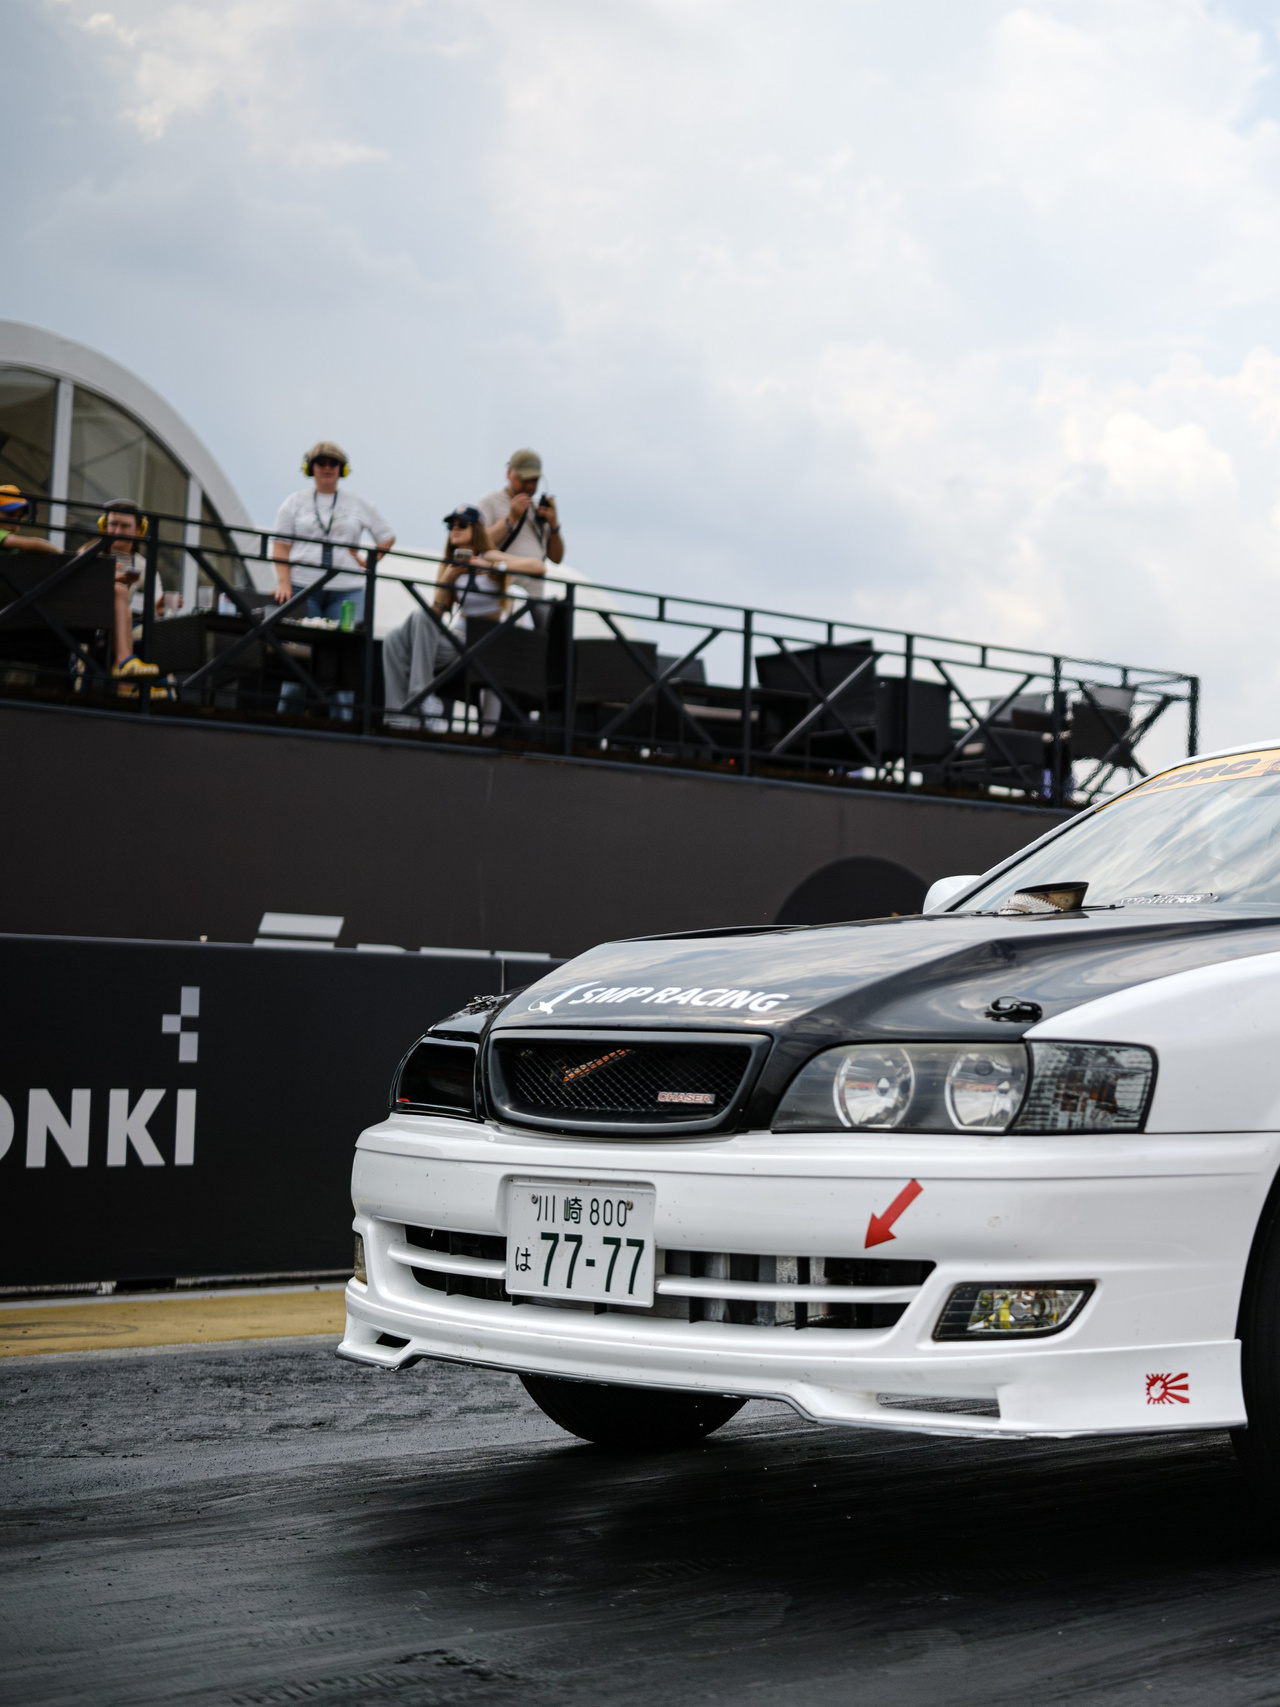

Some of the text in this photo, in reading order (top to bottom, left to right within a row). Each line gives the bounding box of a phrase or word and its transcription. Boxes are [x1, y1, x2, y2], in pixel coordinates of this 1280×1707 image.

[568, 986, 790, 1012] SMP RACING
[657, 1091, 713, 1104] CHASER
[0, 1088, 197, 1168] NKI
[536, 1194, 627, 1227] 川崎 800
[515, 1231, 645, 1295] は 77-77
